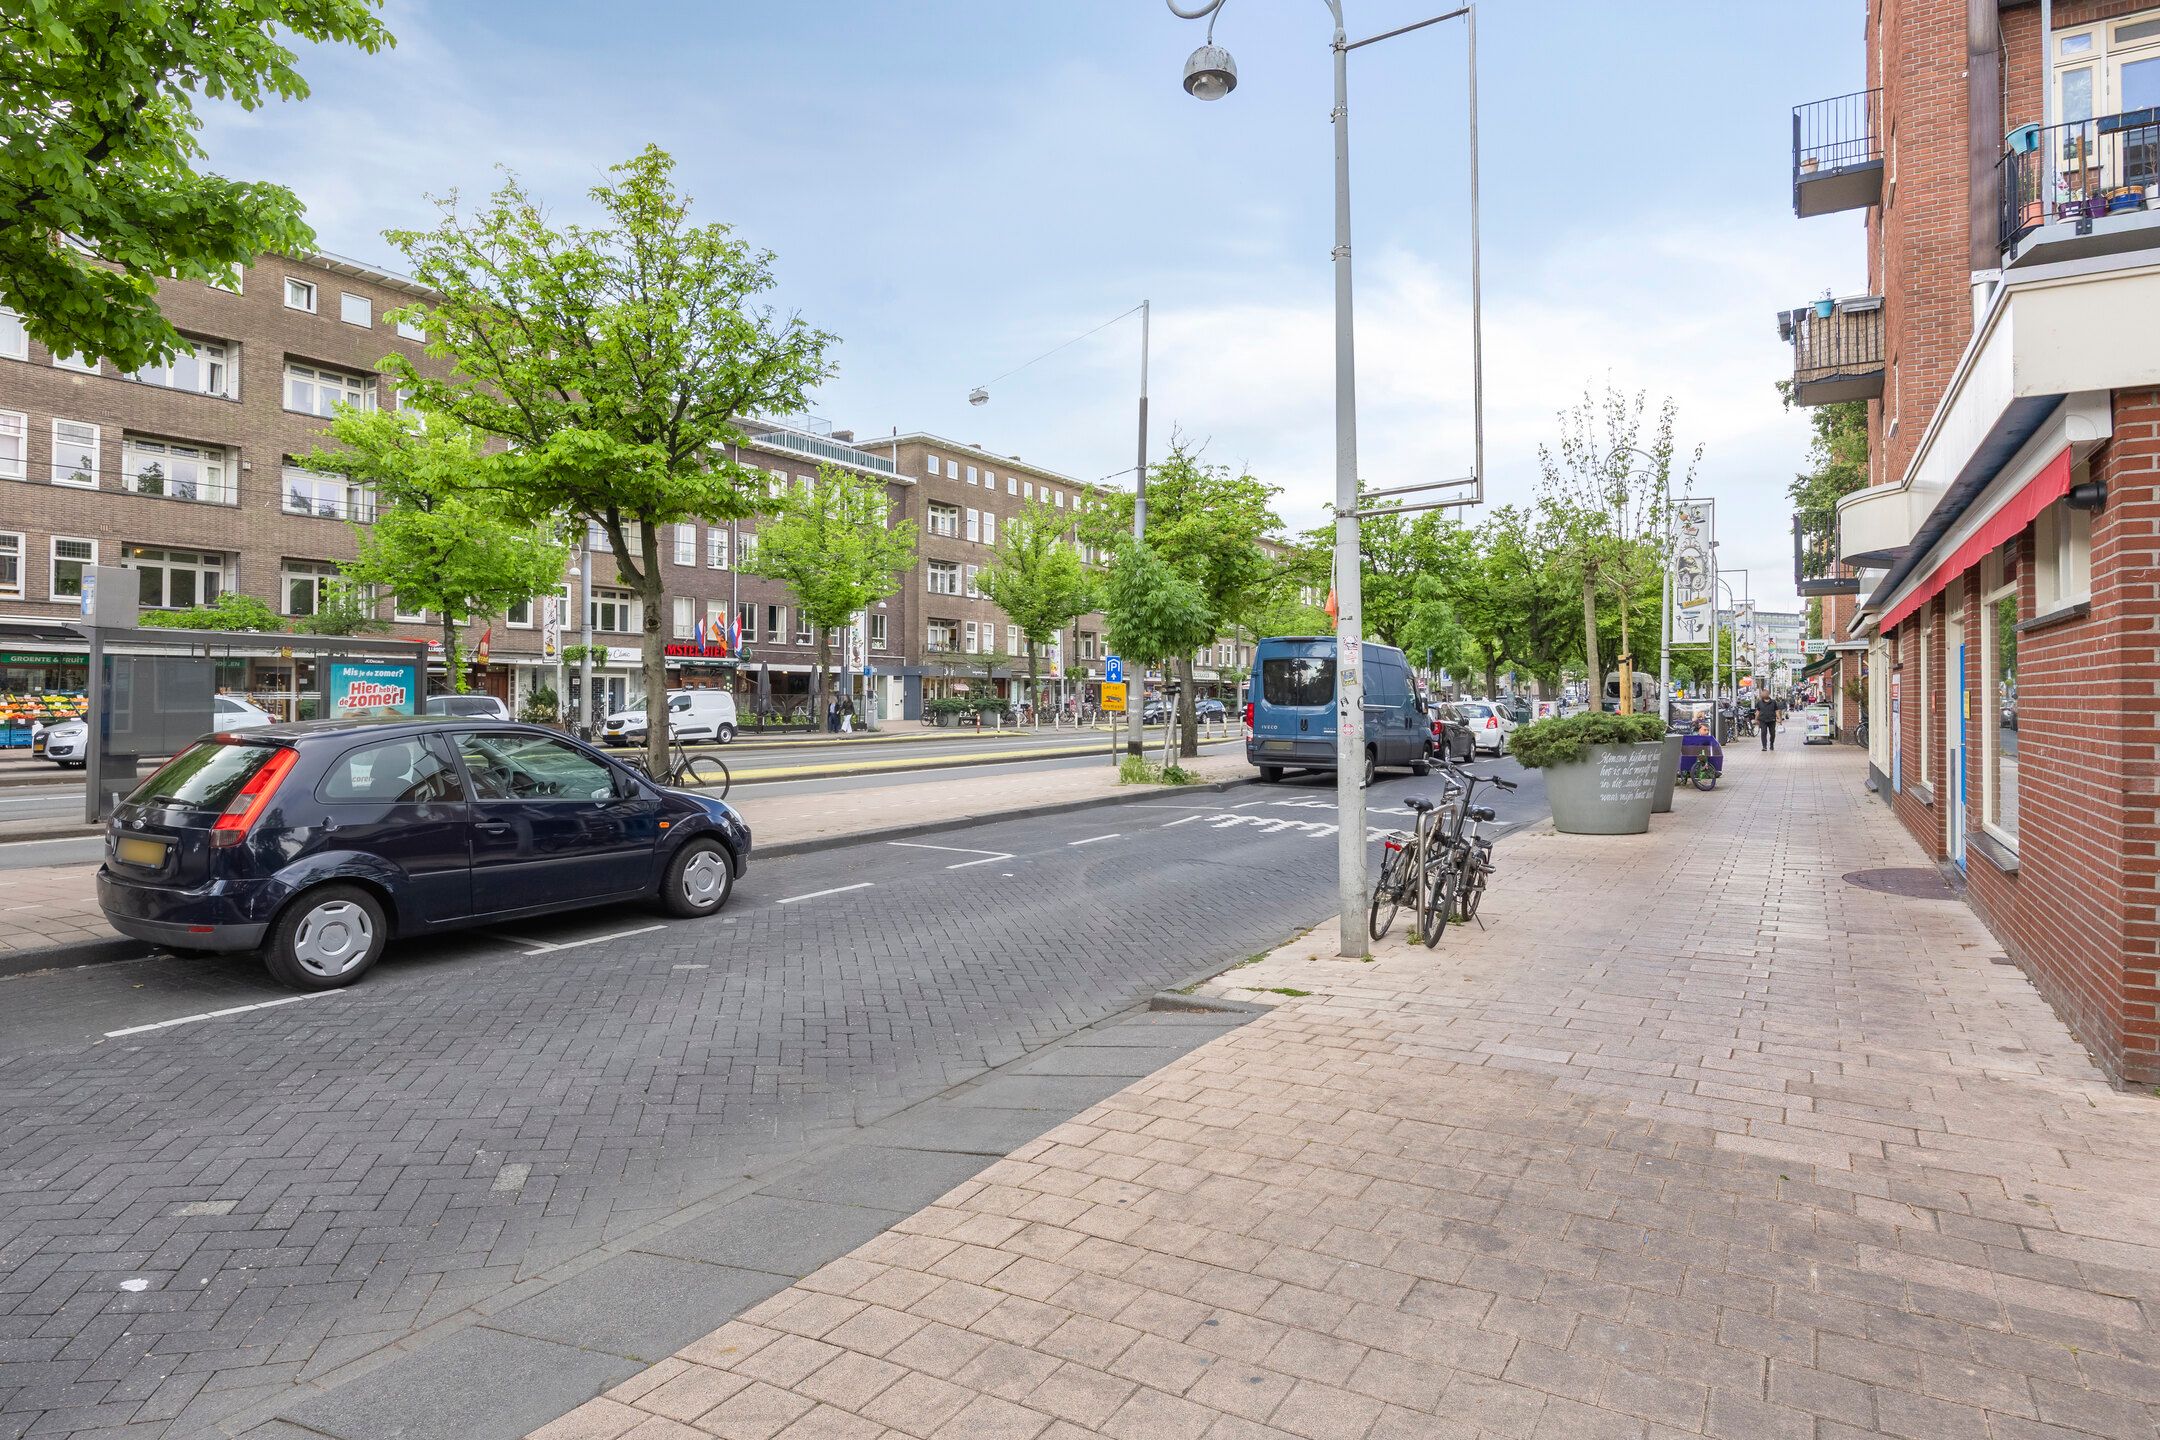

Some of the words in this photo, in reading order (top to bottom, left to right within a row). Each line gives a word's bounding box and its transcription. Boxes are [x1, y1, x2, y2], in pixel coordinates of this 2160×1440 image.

[663, 644, 700, 656] MSTEL
[343, 668, 358, 676] Mis
[374, 669, 404, 677] zomer?
[1110, 662, 1118, 672] P
[351, 682, 378, 694] Hier
[391, 685, 398, 693] je
[348, 688, 404, 708] zomer!
